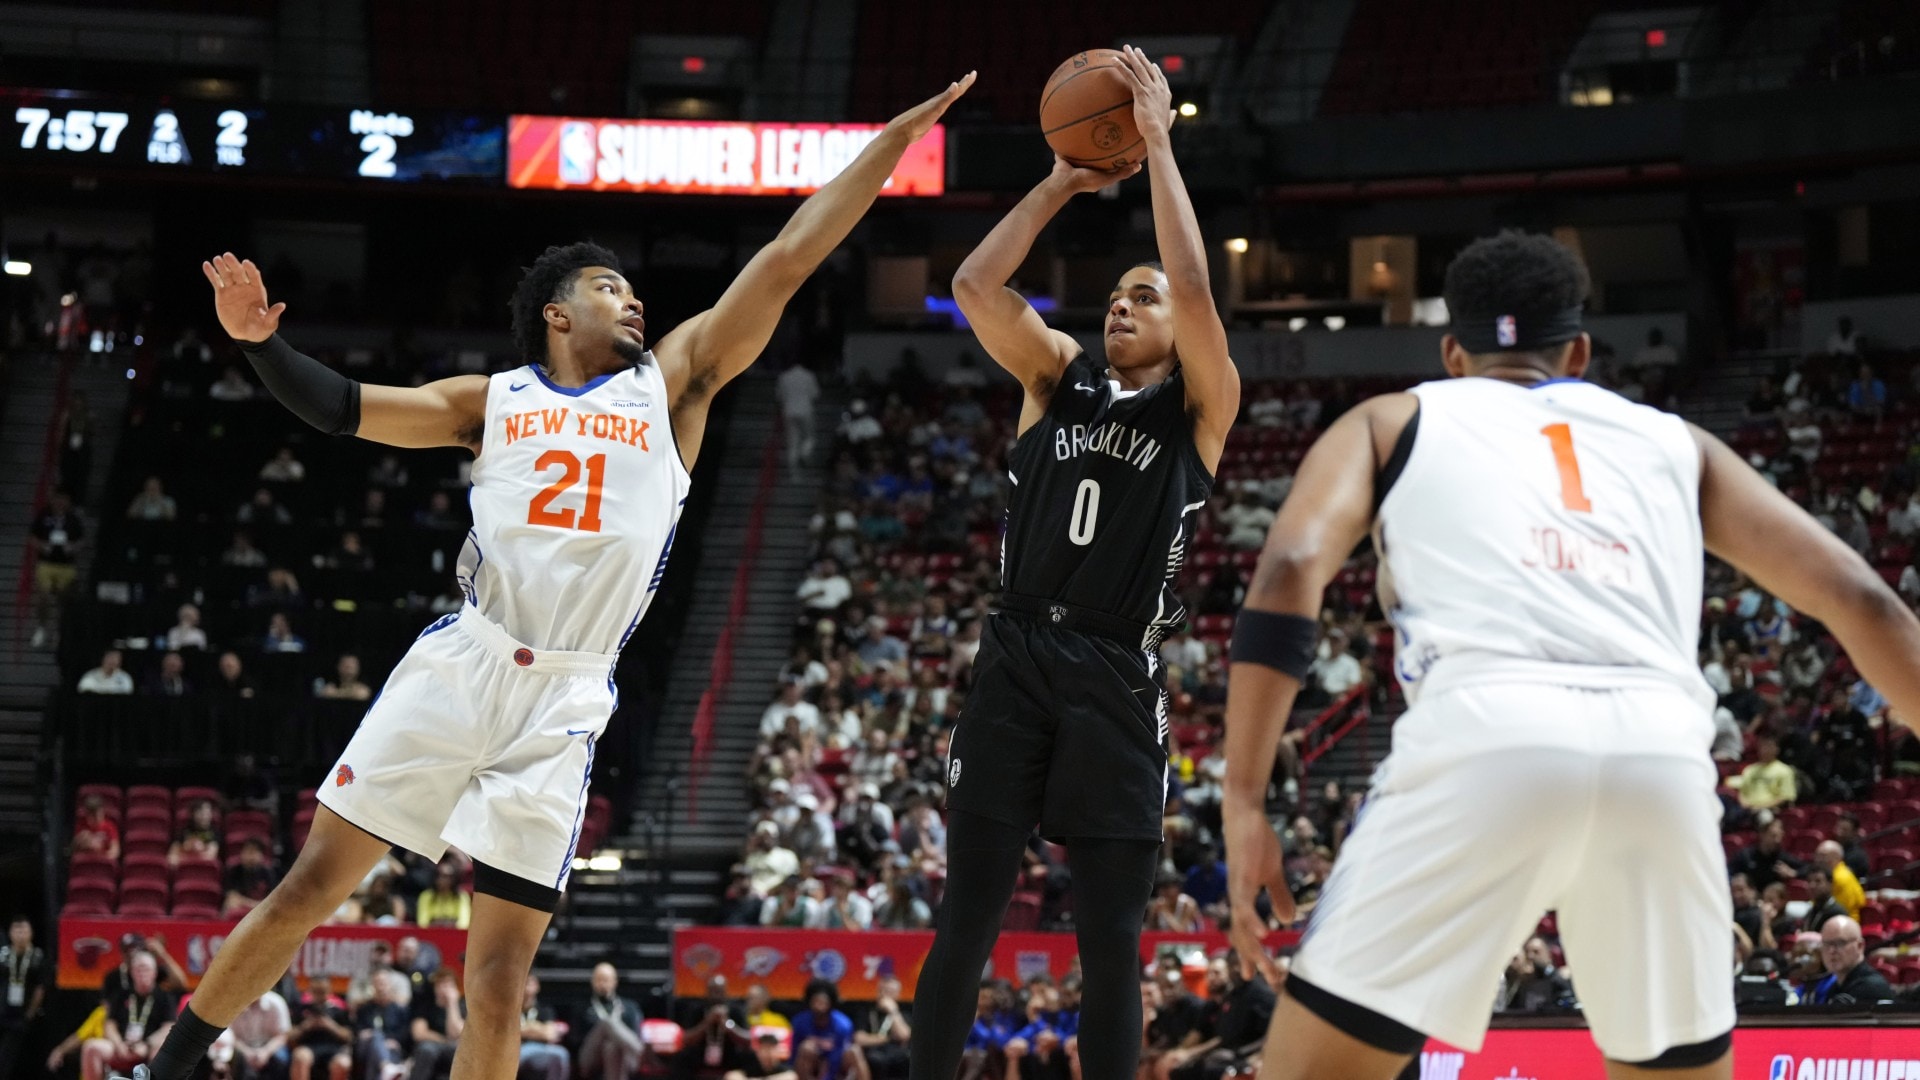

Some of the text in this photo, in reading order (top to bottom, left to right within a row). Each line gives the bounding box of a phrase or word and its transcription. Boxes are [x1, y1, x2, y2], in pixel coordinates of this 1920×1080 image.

[16, 108, 129, 152] 7:57
[154, 113, 178, 142] 2
[216, 110, 248, 147] 2
[349, 109, 414, 136] Nets
[358, 134, 397, 177] 2
[597, 123, 755, 186] SUMMER
[505, 408, 650, 453] NEW YORK
[1540, 423, 1592, 513] 1
[527, 450, 606, 532] 21
[1069, 478, 1100, 545] 0
